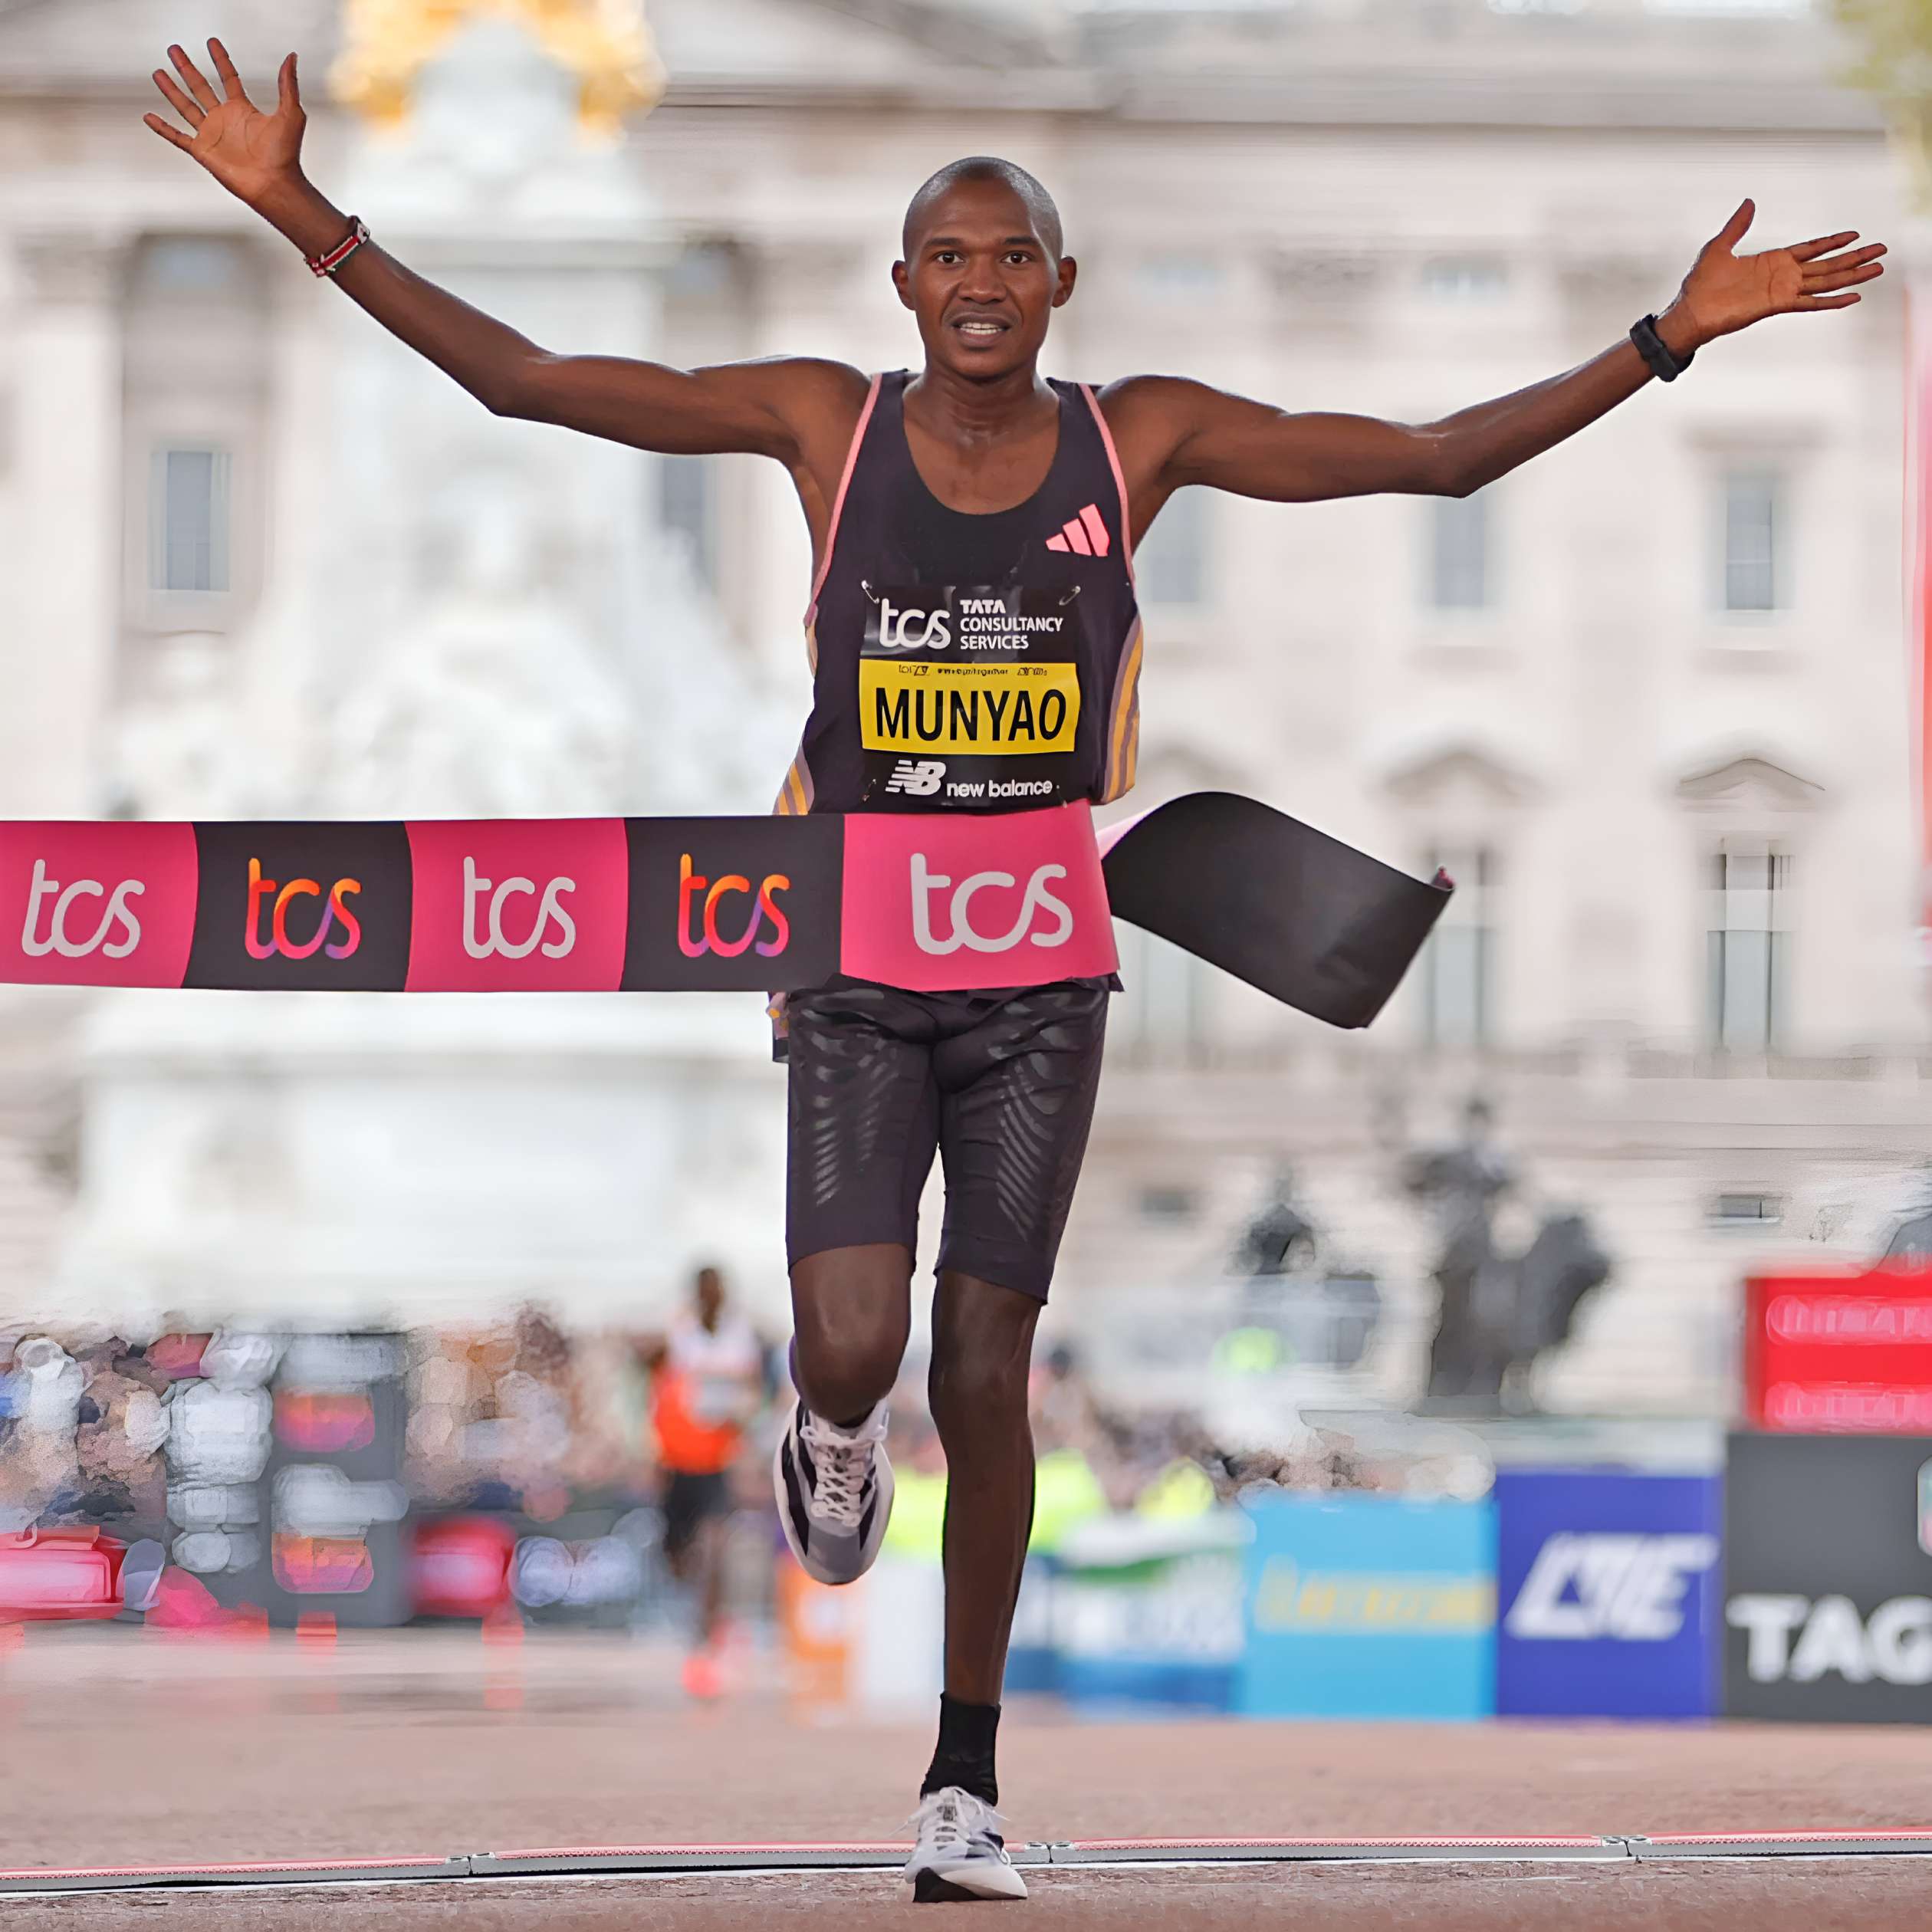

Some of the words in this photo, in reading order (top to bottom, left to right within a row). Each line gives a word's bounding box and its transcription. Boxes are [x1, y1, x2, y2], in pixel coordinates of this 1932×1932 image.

[879, 598, 951, 649] tcs
[960, 600, 1006, 614] TATA
[960, 616, 1063, 632] CONSULTANCY
[960, 635, 1029, 650] SERVICES
[876, 687, 1066, 741] MUNYAO
[947, 782, 984, 797] new
[988, 779, 1053, 797] balance
[21, 859, 146, 958] tcs
[245, 857, 362, 960] tcs
[462, 856, 577, 959] tcs
[677, 853, 791, 958] tcs
[910, 853, 1073, 955] tcs
[1726, 1594, 1932, 1685] TAG
